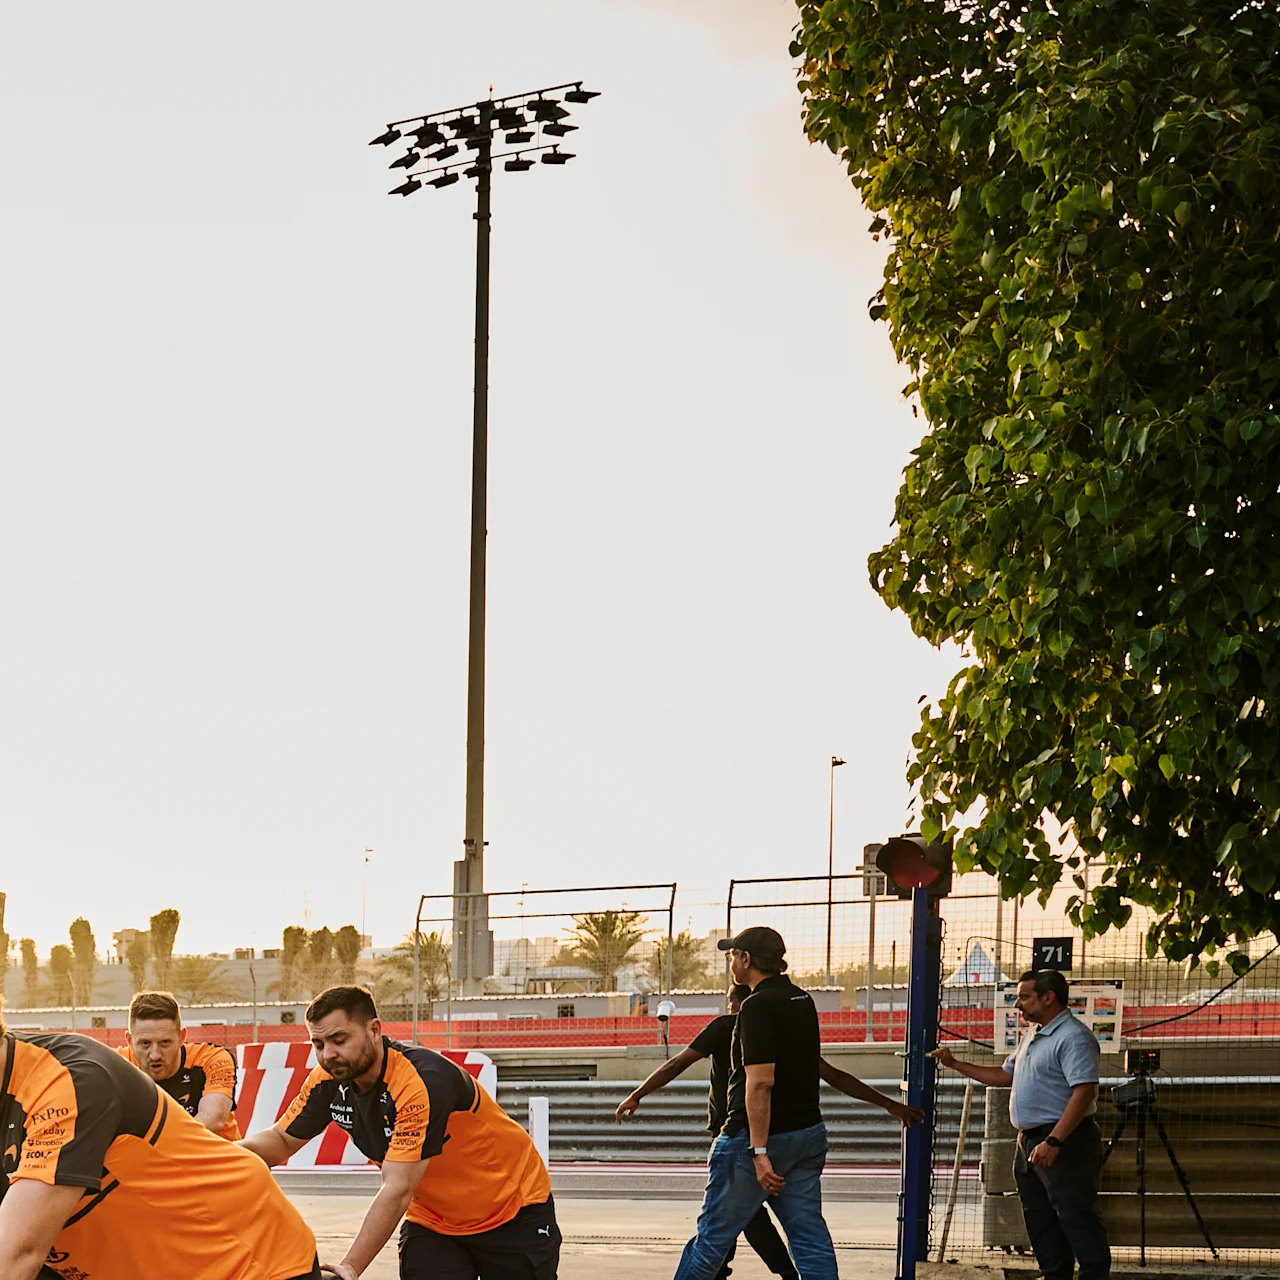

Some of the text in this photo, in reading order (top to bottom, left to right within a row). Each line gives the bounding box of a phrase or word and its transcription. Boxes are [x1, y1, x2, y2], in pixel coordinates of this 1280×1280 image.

[1041, 945, 1064, 963] 71
[31, 1107, 70, 1126] FxPro
[331, 1112, 353, 1124] DELL
[43, 1127, 66, 1137] kday
[35, 1139, 64, 1147] Dropbox
